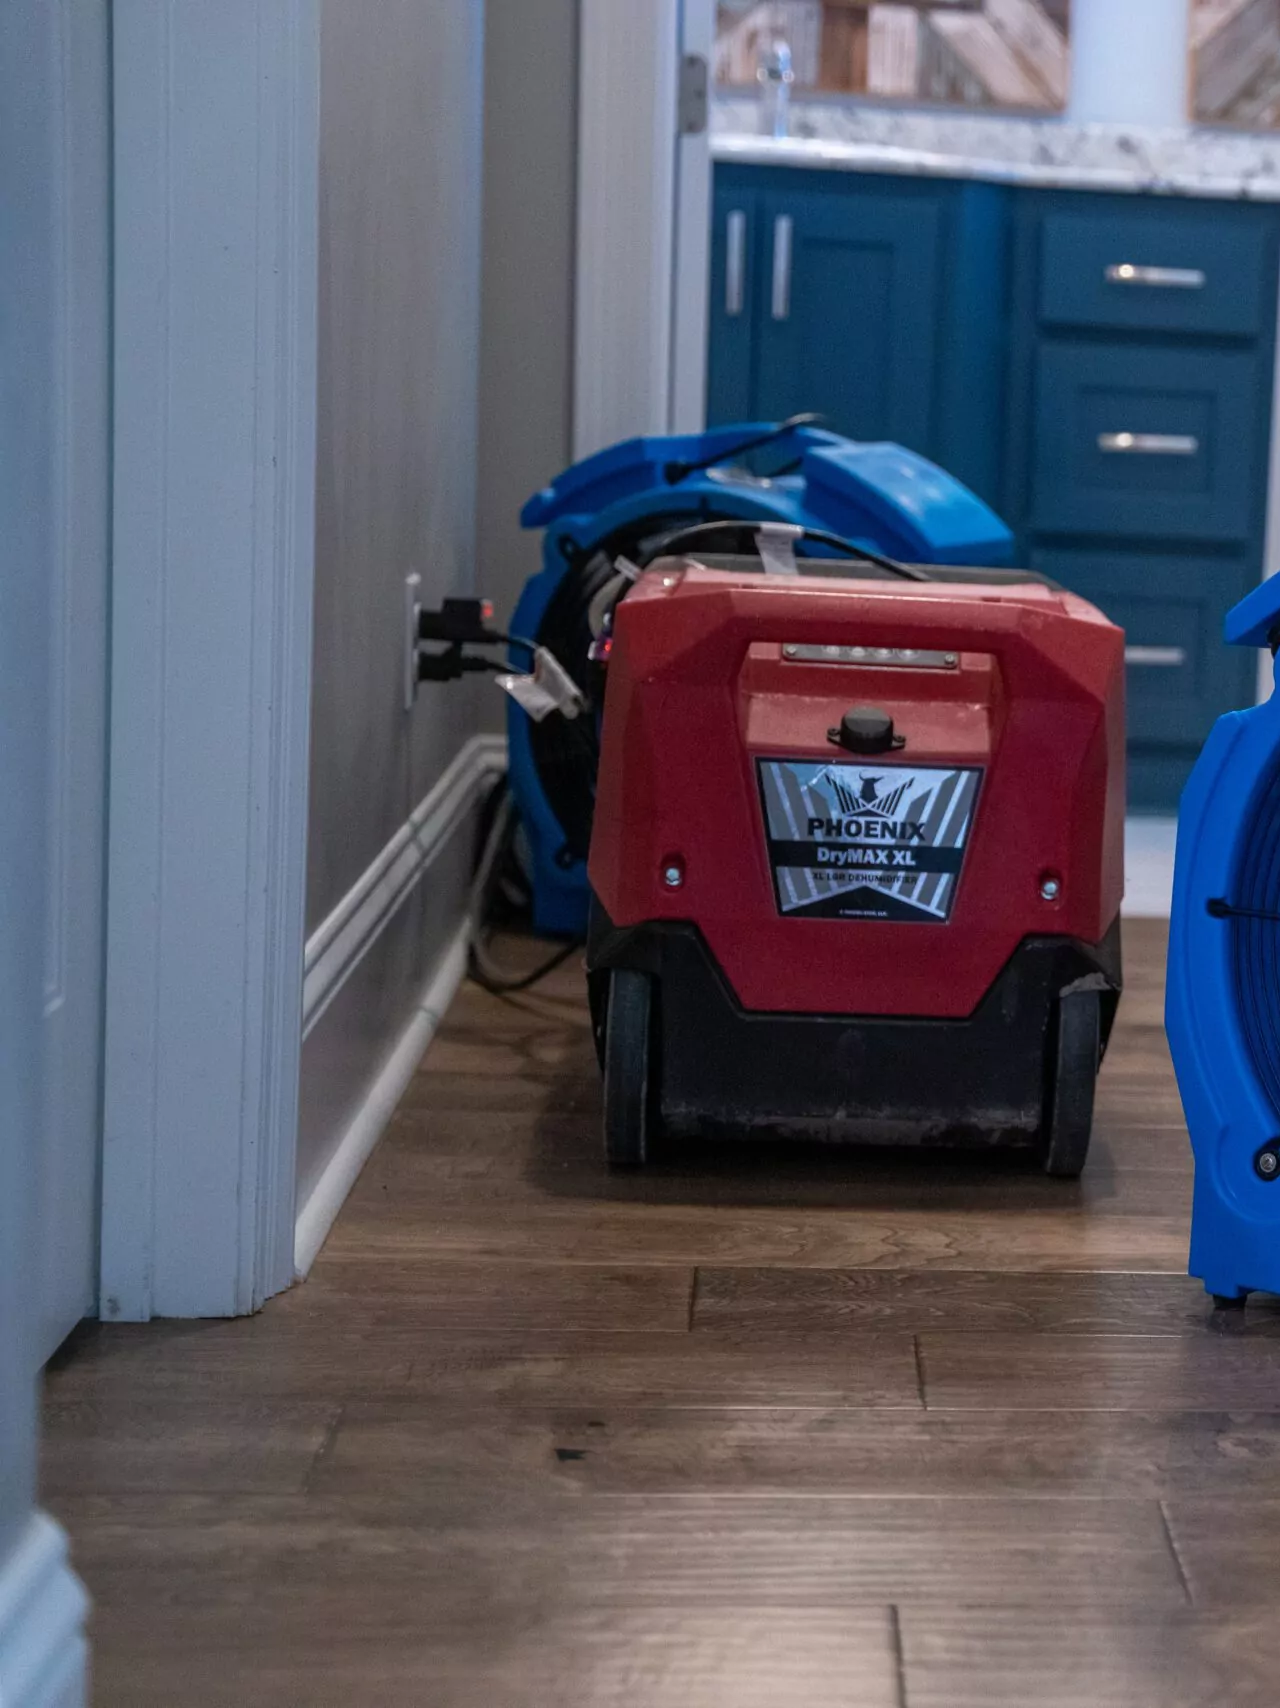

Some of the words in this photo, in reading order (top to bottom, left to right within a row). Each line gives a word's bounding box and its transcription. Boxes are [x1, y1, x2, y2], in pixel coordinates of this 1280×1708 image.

[807, 818, 926, 841] PHOENIX
[817, 847, 888, 866] DryMAX
[892, 850, 916, 866] XL
[848, 873, 917, 885] DEHUMIDIFIER
